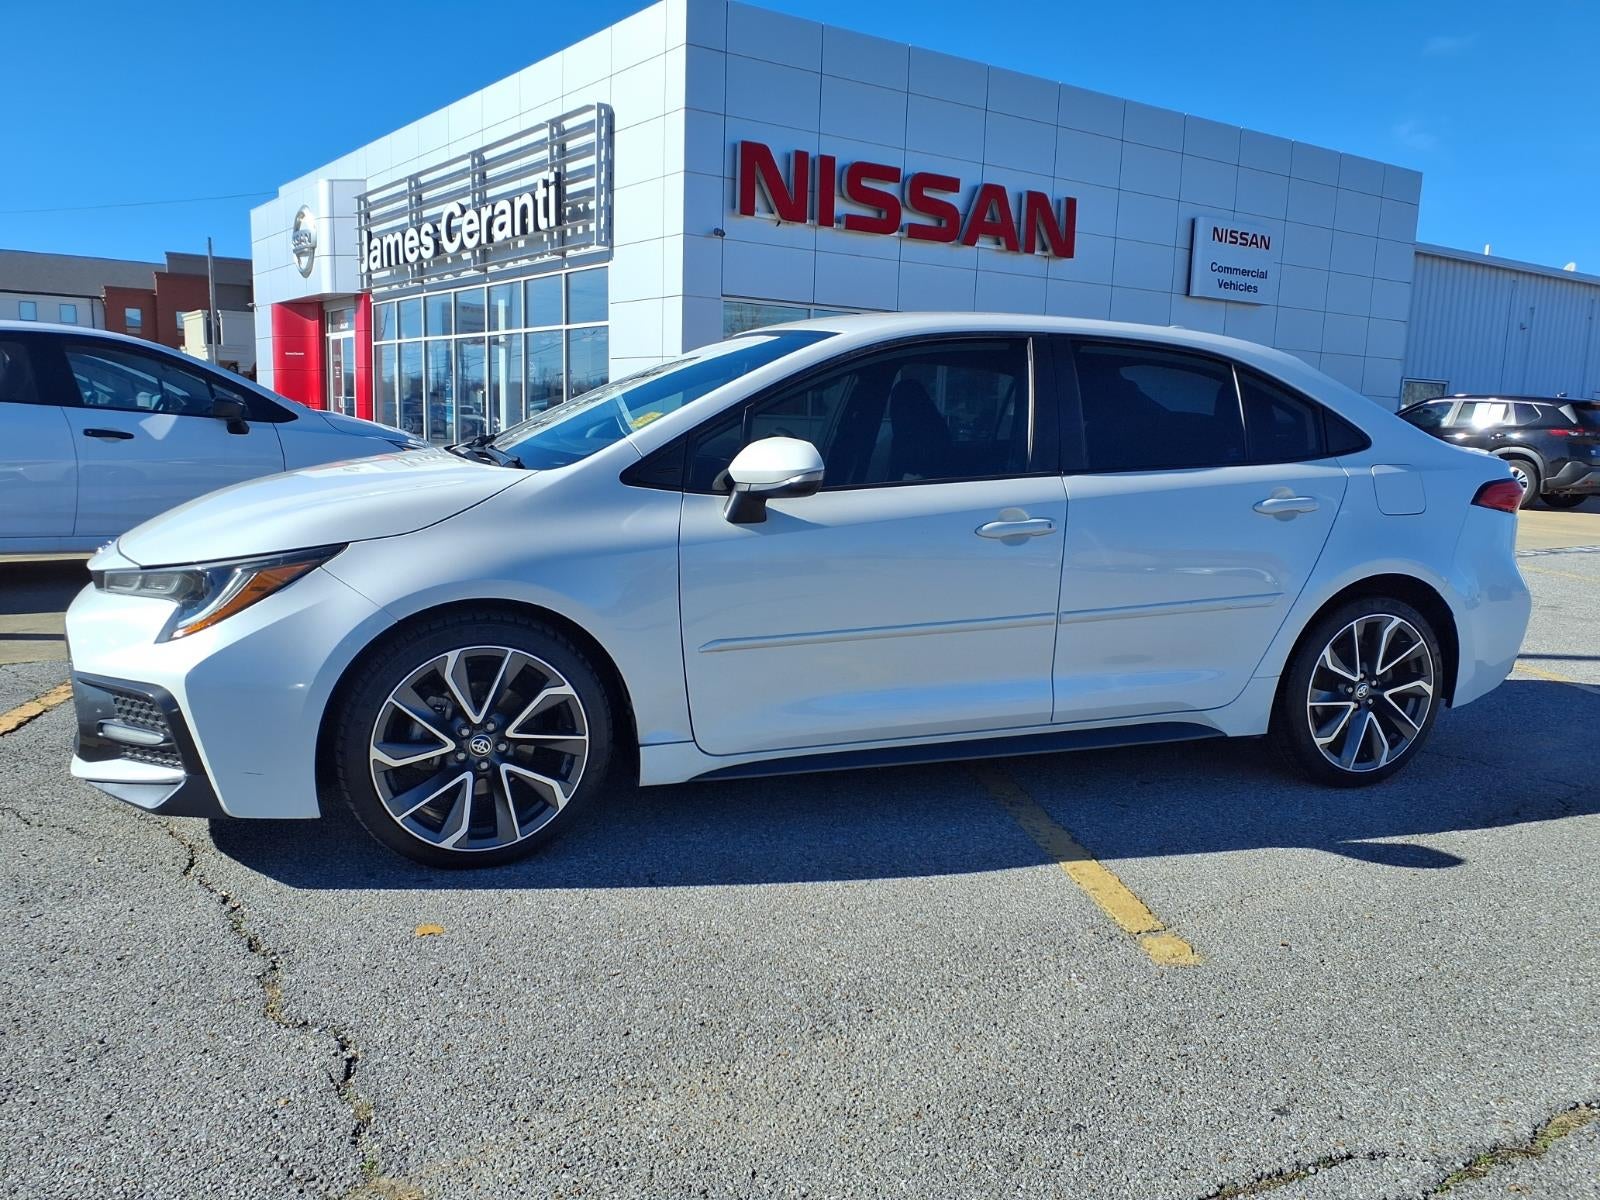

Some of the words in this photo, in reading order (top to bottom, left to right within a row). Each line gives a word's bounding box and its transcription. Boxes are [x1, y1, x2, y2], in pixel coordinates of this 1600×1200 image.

[737, 140, 1078, 259] NISSAN
[361, 223, 435, 273] James
[441, 172, 556, 253] Ceranti
[1212, 226, 1271, 250] NISSAN
[1210, 261, 1268, 279] Commercial
[1217, 278, 1258, 293] Vehicles
